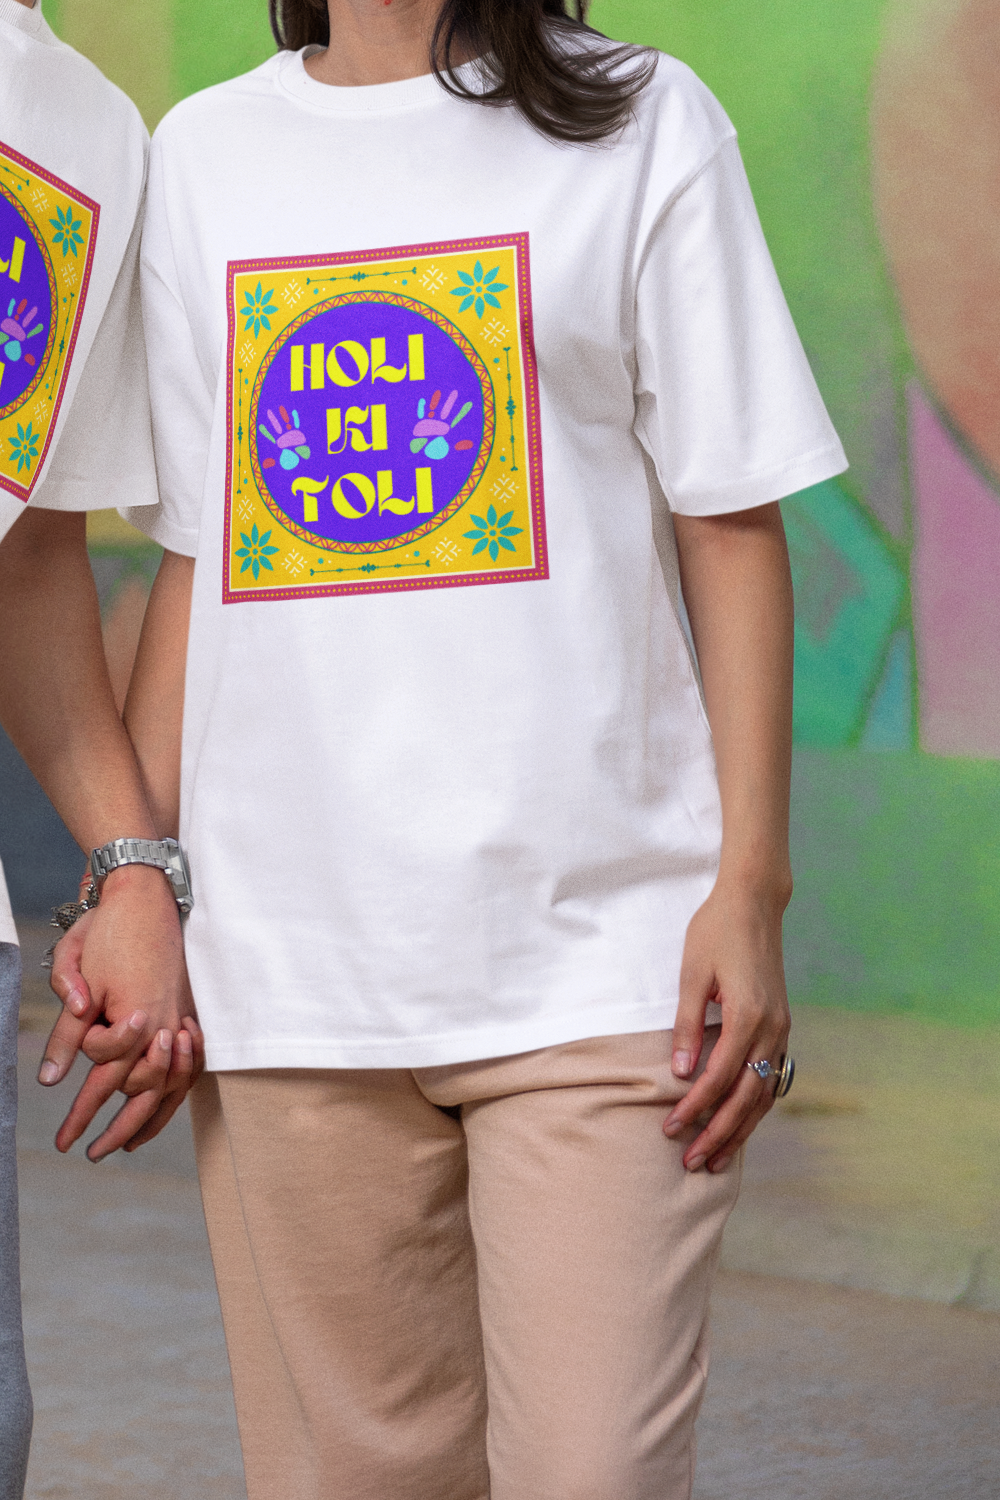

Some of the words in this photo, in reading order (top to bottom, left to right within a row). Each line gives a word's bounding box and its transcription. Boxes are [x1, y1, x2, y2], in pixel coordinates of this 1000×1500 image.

[290, 333, 426, 392] HOLI
[326, 403, 388, 455] KI
[291, 466, 434, 523] TOLI
